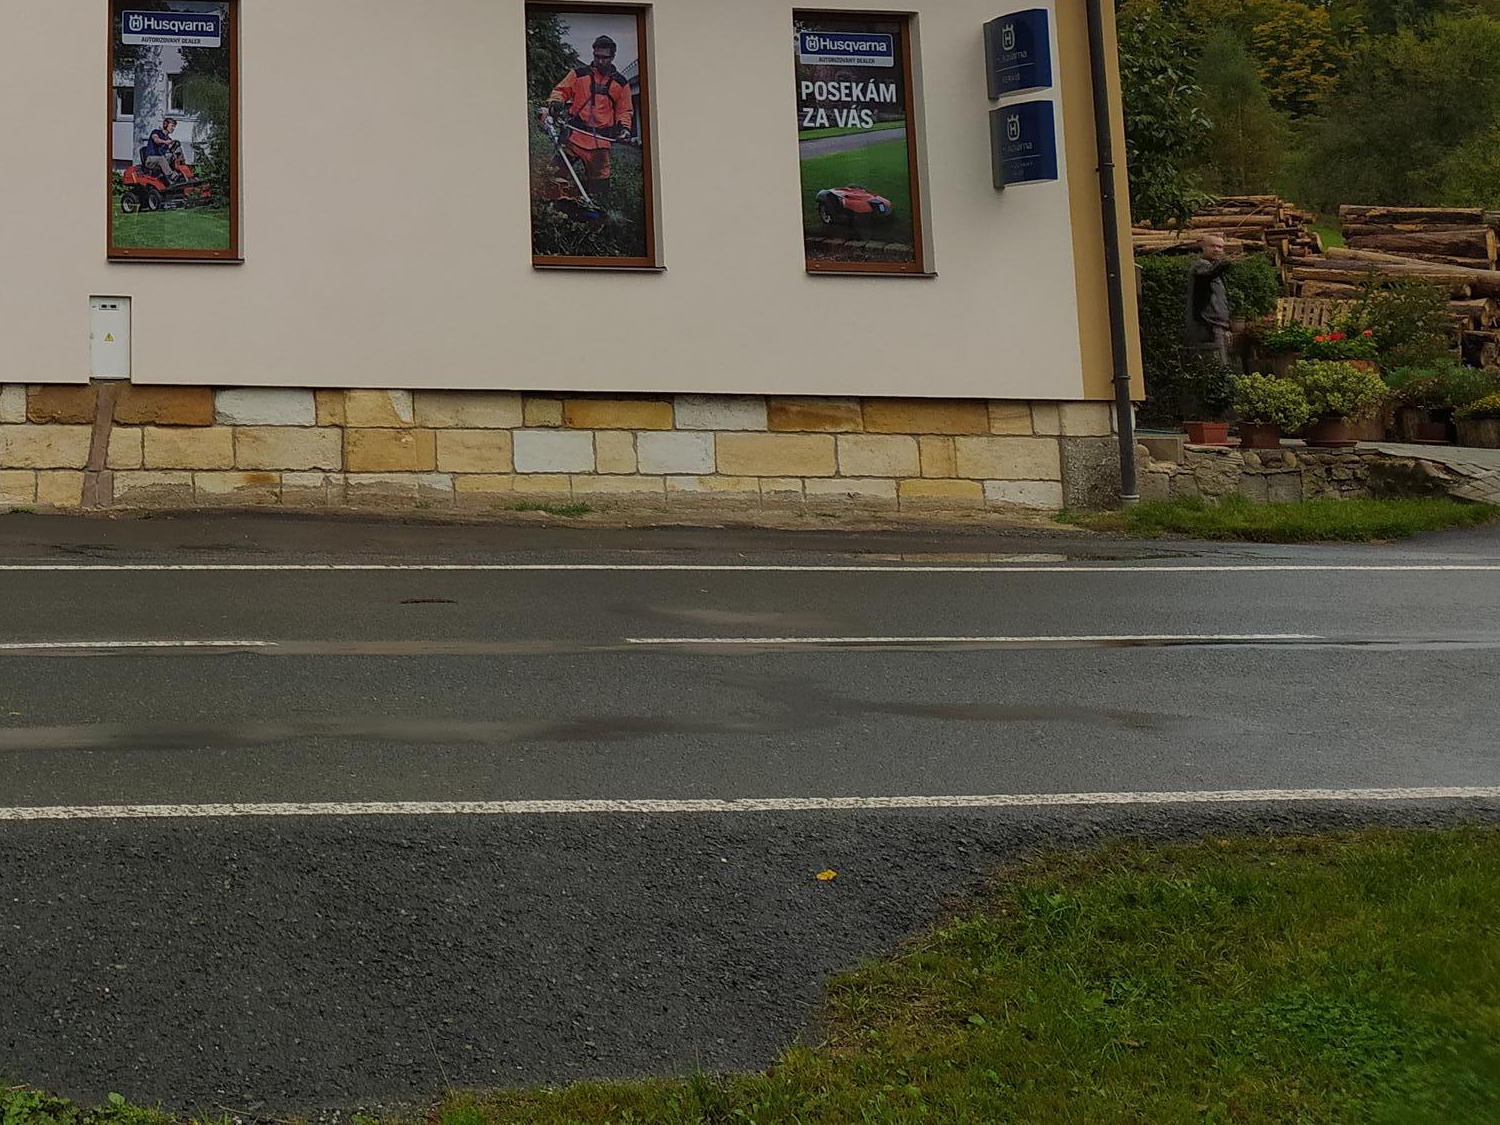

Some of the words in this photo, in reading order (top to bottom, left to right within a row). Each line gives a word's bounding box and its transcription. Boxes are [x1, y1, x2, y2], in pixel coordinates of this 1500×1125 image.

[144, 17, 214, 32] Husqvarna
[820, 37, 887, 52] Husqvarna
[801, 78, 896, 103] POSEKÁM
[803, 108, 829, 127] ZA
[834, 105, 874, 129] VÁS
